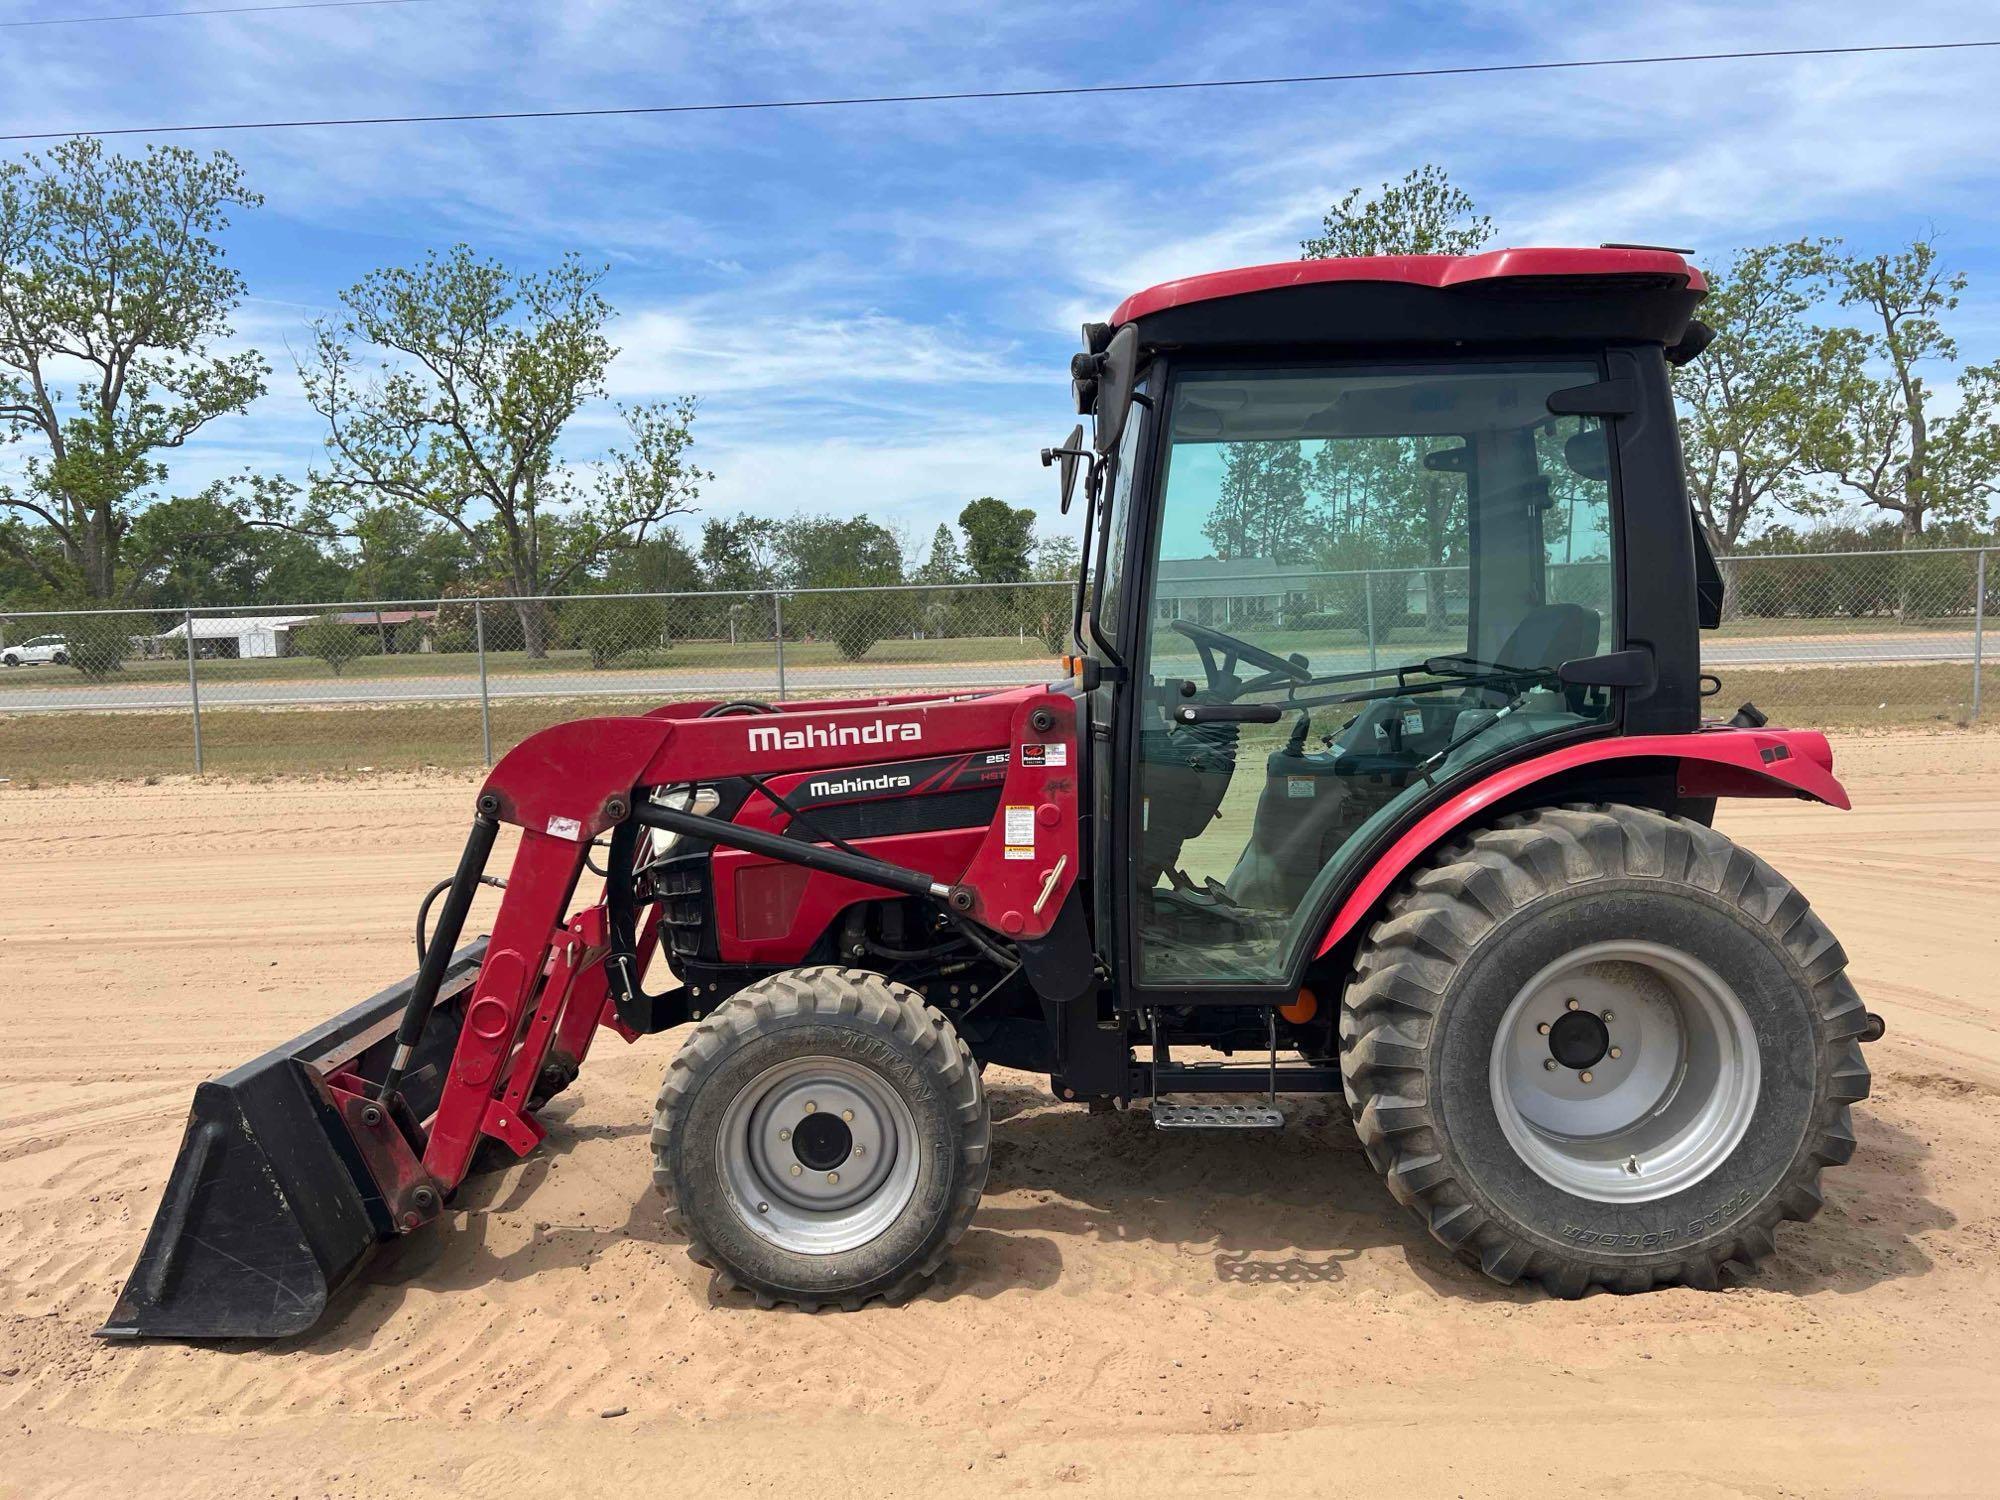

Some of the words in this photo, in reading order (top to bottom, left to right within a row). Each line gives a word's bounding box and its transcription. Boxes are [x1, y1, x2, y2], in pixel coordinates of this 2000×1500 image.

[748, 719, 922, 752] Mahindra
[809, 774, 911, 797] Mahindra
[839, 1029, 937, 1103] TITAN
[1561, 1223, 1679, 1247] LOADER
